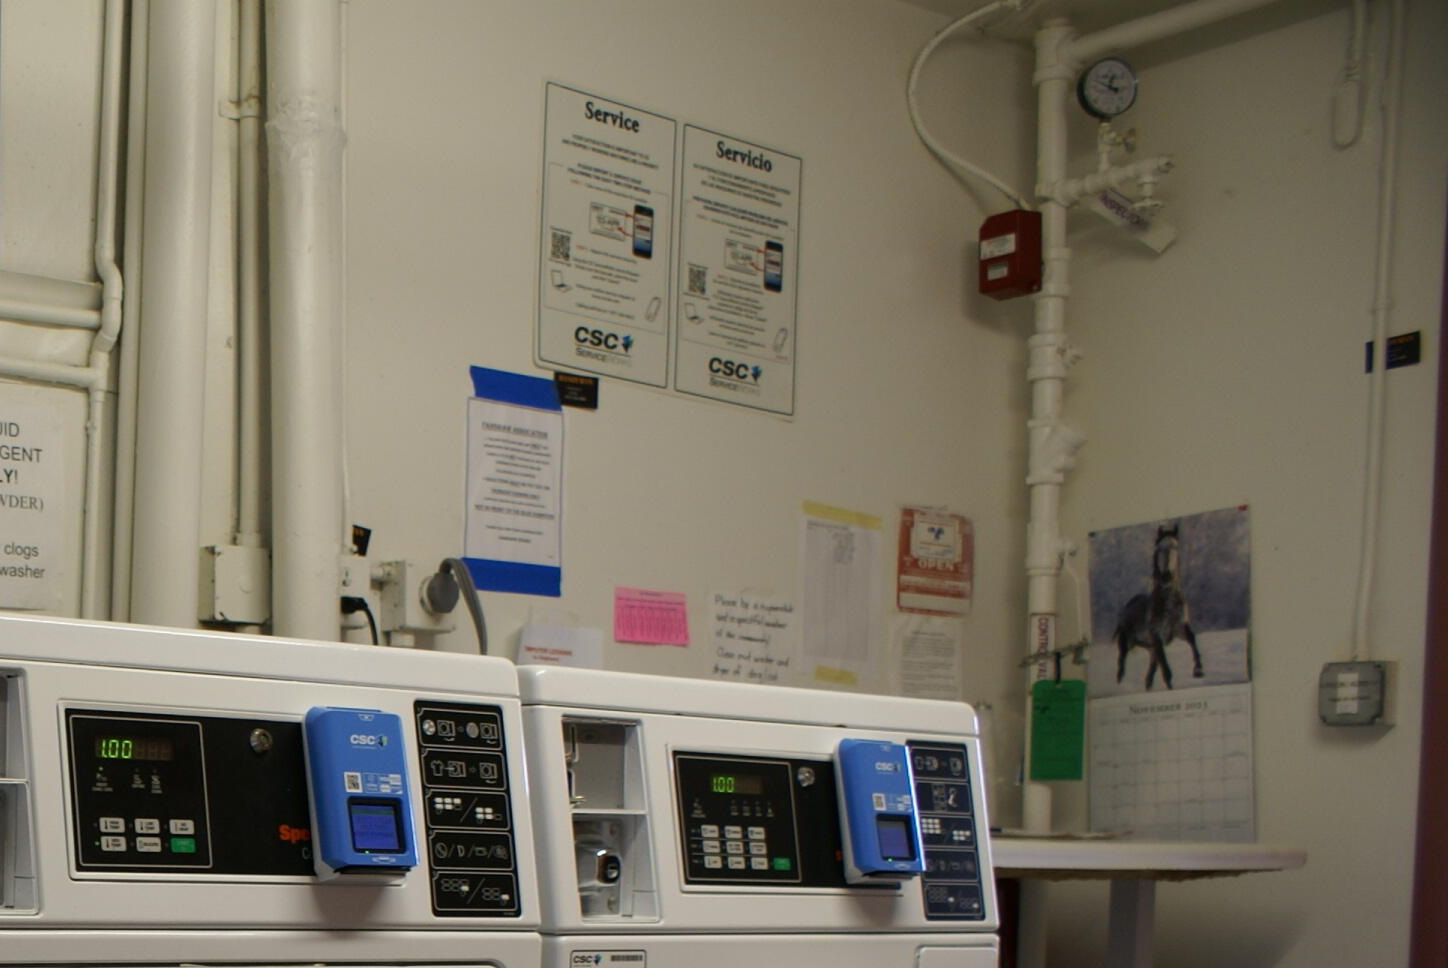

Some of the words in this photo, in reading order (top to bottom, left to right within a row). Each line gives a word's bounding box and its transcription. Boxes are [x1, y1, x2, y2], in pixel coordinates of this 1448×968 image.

[585, 101, 640, 134] Service
[716, 140, 773, 174] Servicio
[574, 326, 619, 350] CSC
[709, 357, 749, 379] CSC
[4, 542, 39, 560] clogs
[102, 739, 132, 759] 1.00
[350, 734, 376, 745] CSC
[875, 762, 893, 771] CSC
[279, 824, 311, 844] Spe
[573, 955, 593, 963] CSC
